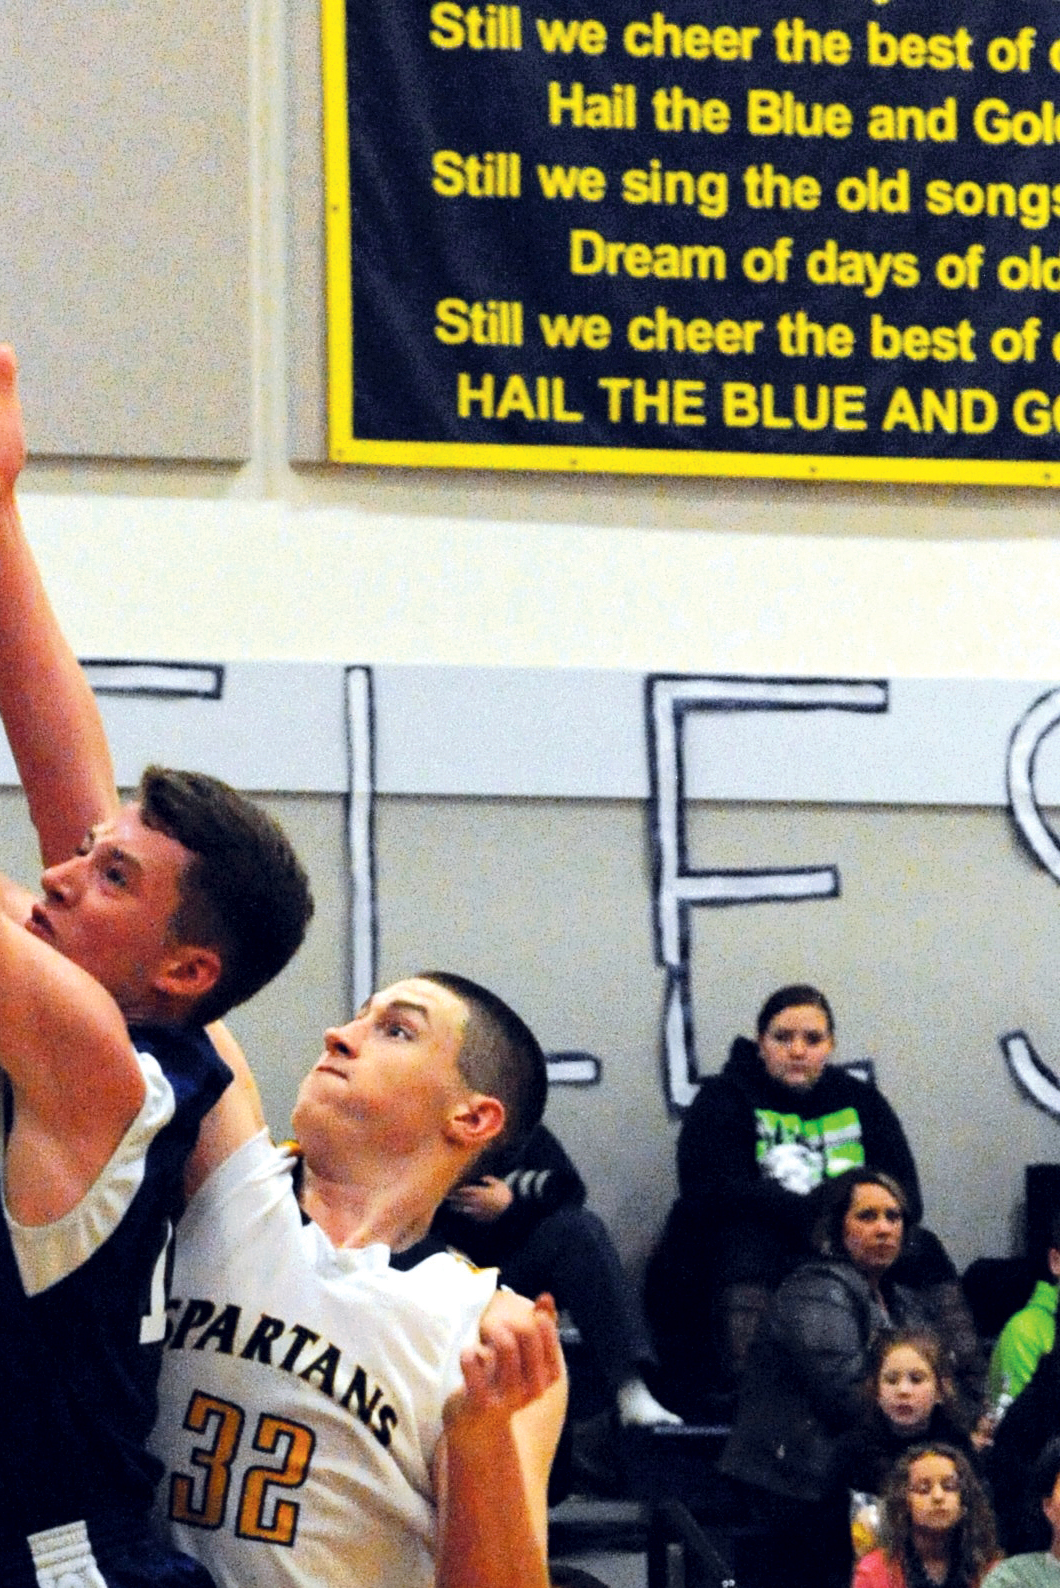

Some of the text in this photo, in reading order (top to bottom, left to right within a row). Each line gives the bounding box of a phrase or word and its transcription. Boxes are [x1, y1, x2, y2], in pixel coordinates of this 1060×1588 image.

[429, 2, 523, 49] Still
[538, 19, 608, 54] we
[624, 12, 761, 61] cheer
[773, 17, 852, 65] the
[867, 21, 974, 71] best
[987, 27, 1037, 73] of
[548, 81, 1060, 147] Hail the Blue and Gol
[432, 149, 521, 197] Still
[537, 165, 606, 201] we
[622, 159, 729, 219] sing
[744, 163, 822, 211] the
[836, 167, 911, 213] old
[570, 229, 727, 281] Dream
[742, 236, 793, 283] of
[806, 239, 920, 299] days
[936, 243, 985, 289] of
[435, 298, 524, 347] Still
[540, 314, 612, 349] we
[627, 305, 764, 355] cheer
[776, 311, 855, 359] the
[870, 313, 976, 363] best
[990, 316, 1042, 363] of
[457, 372, 1060, 437] HAIL THE BLUE AND G
[168, 1389, 317, 1548] 32
